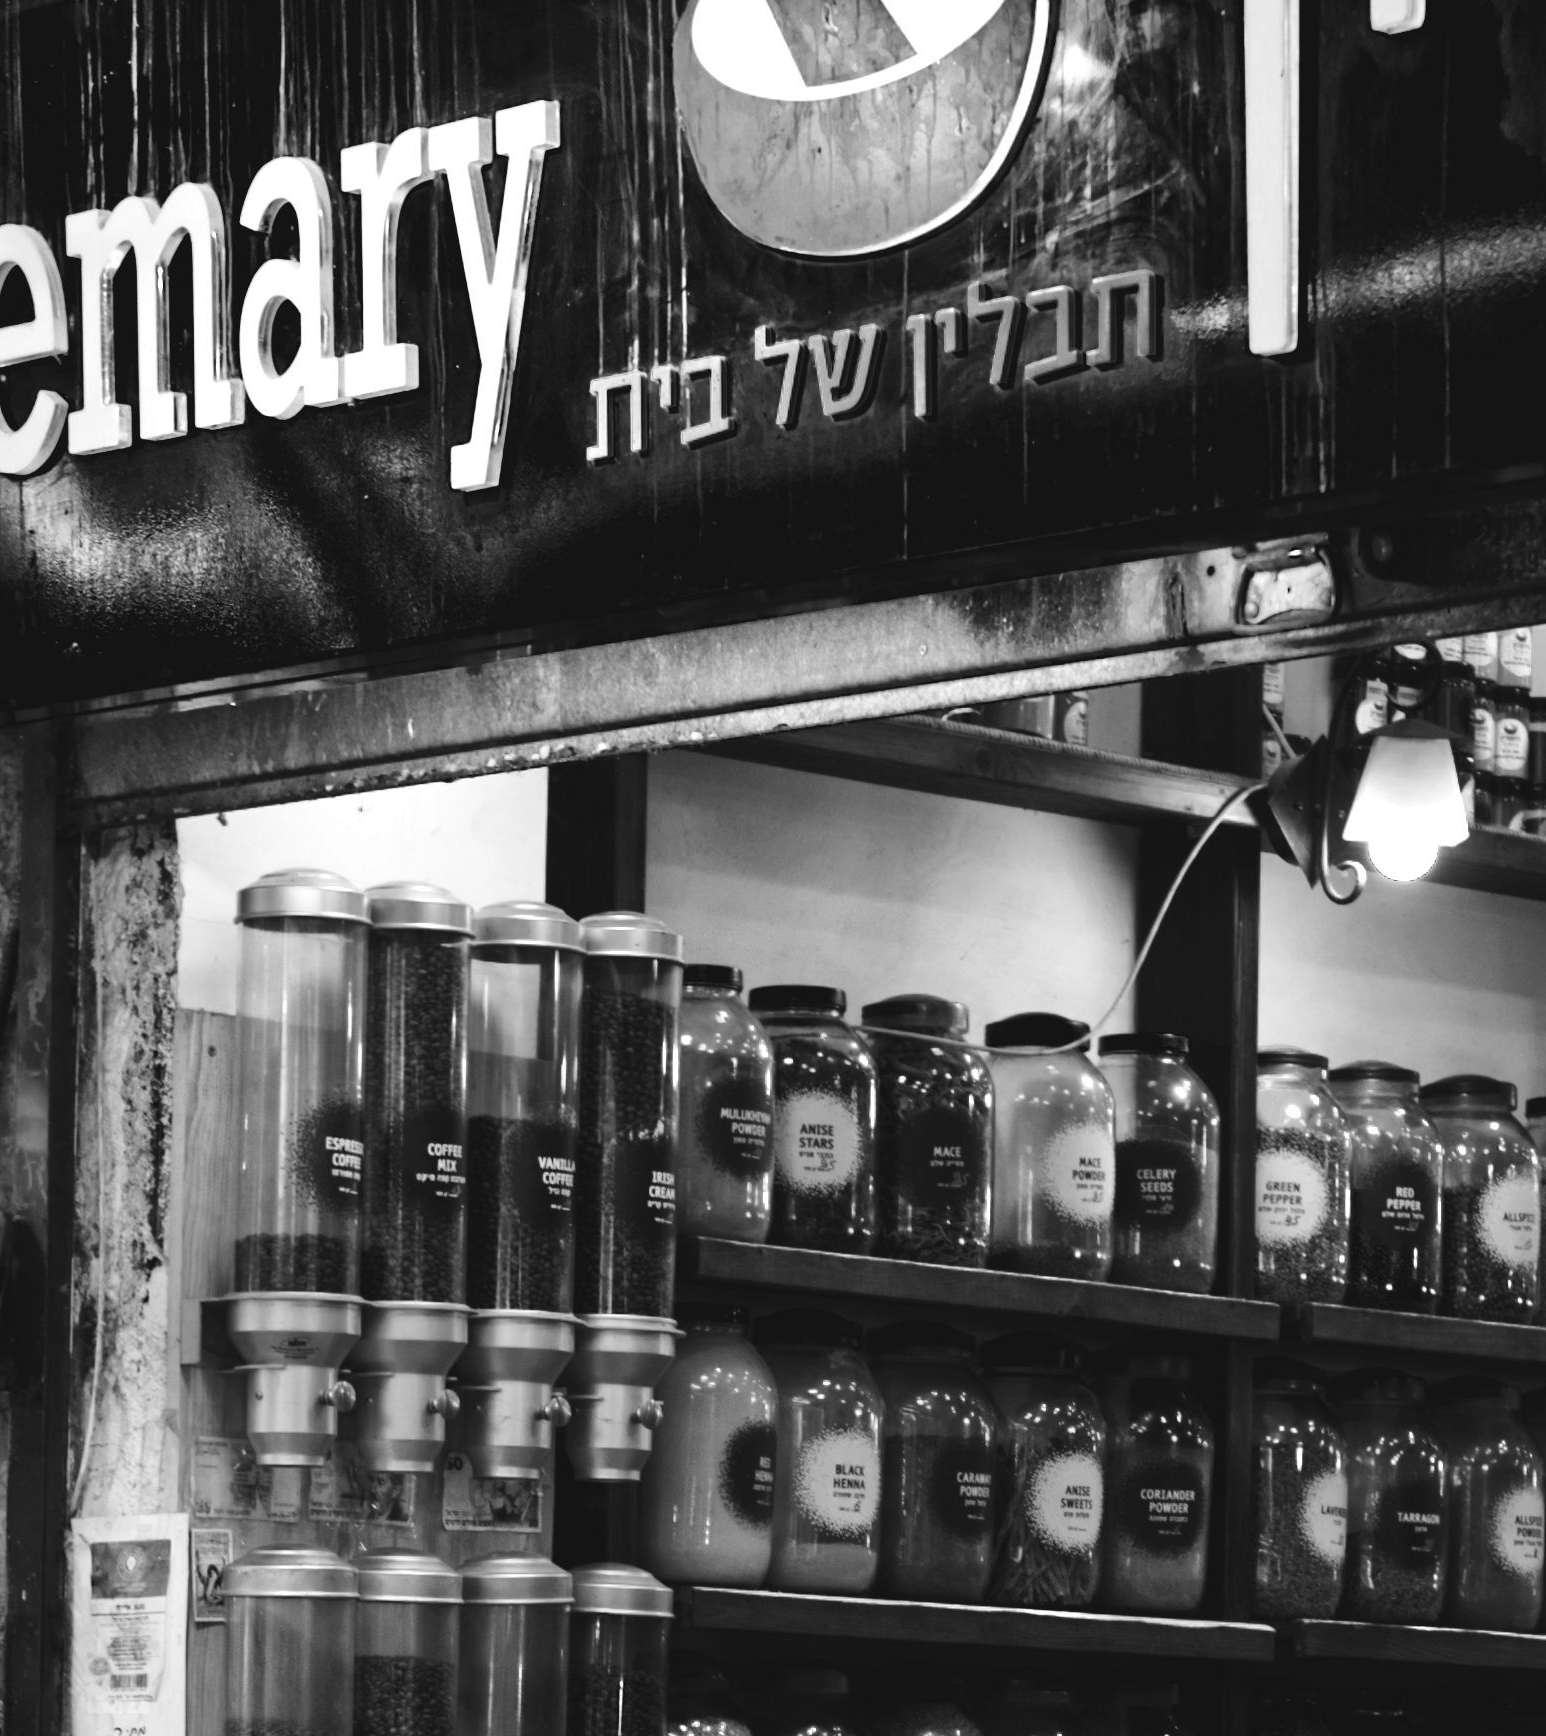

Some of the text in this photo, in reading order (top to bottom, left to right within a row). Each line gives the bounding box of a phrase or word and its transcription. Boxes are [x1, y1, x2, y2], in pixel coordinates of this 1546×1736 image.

[585, 267, 1161, 468] תבלין של בית
[731, 1121, 766, 1138] POWDER
[799, 1123, 835, 1136] ANISE
[798, 1136, 835, 1150] STARS
[427, 1142, 463, 1158] COFFEE
[932, 1145, 962, 1158] MACE
[437, 1158, 458, 1173] MIX
[1078, 1156, 1102, 1169] MACE
[542, 1171, 574, 1187] COFFEE
[1071, 1169, 1106, 1182] POWDER
[1136, 1167, 1177, 1181] CELERY
[1139, 1181, 1174, 1194] SEEDS
[1265, 1180, 1301, 1193] GREEN
[1395, 1186, 1415, 1199] RED
[1262, 1193, 1303, 1206] PEPPER
[1386, 1198, 1422, 1212] PEPPER
[834, 1464, 865, 1477] BLACK
[832, 1477, 865, 1490] HENNA
[959, 1485, 990, 1498] POWDER
[1064, 1484, 1091, 1497] ANISE
[1140, 1488, 1196, 1502] CORIANDER
[1060, 1497, 1093, 1510] SWEETS
[1148, 1501, 1189, 1514] POWDER
